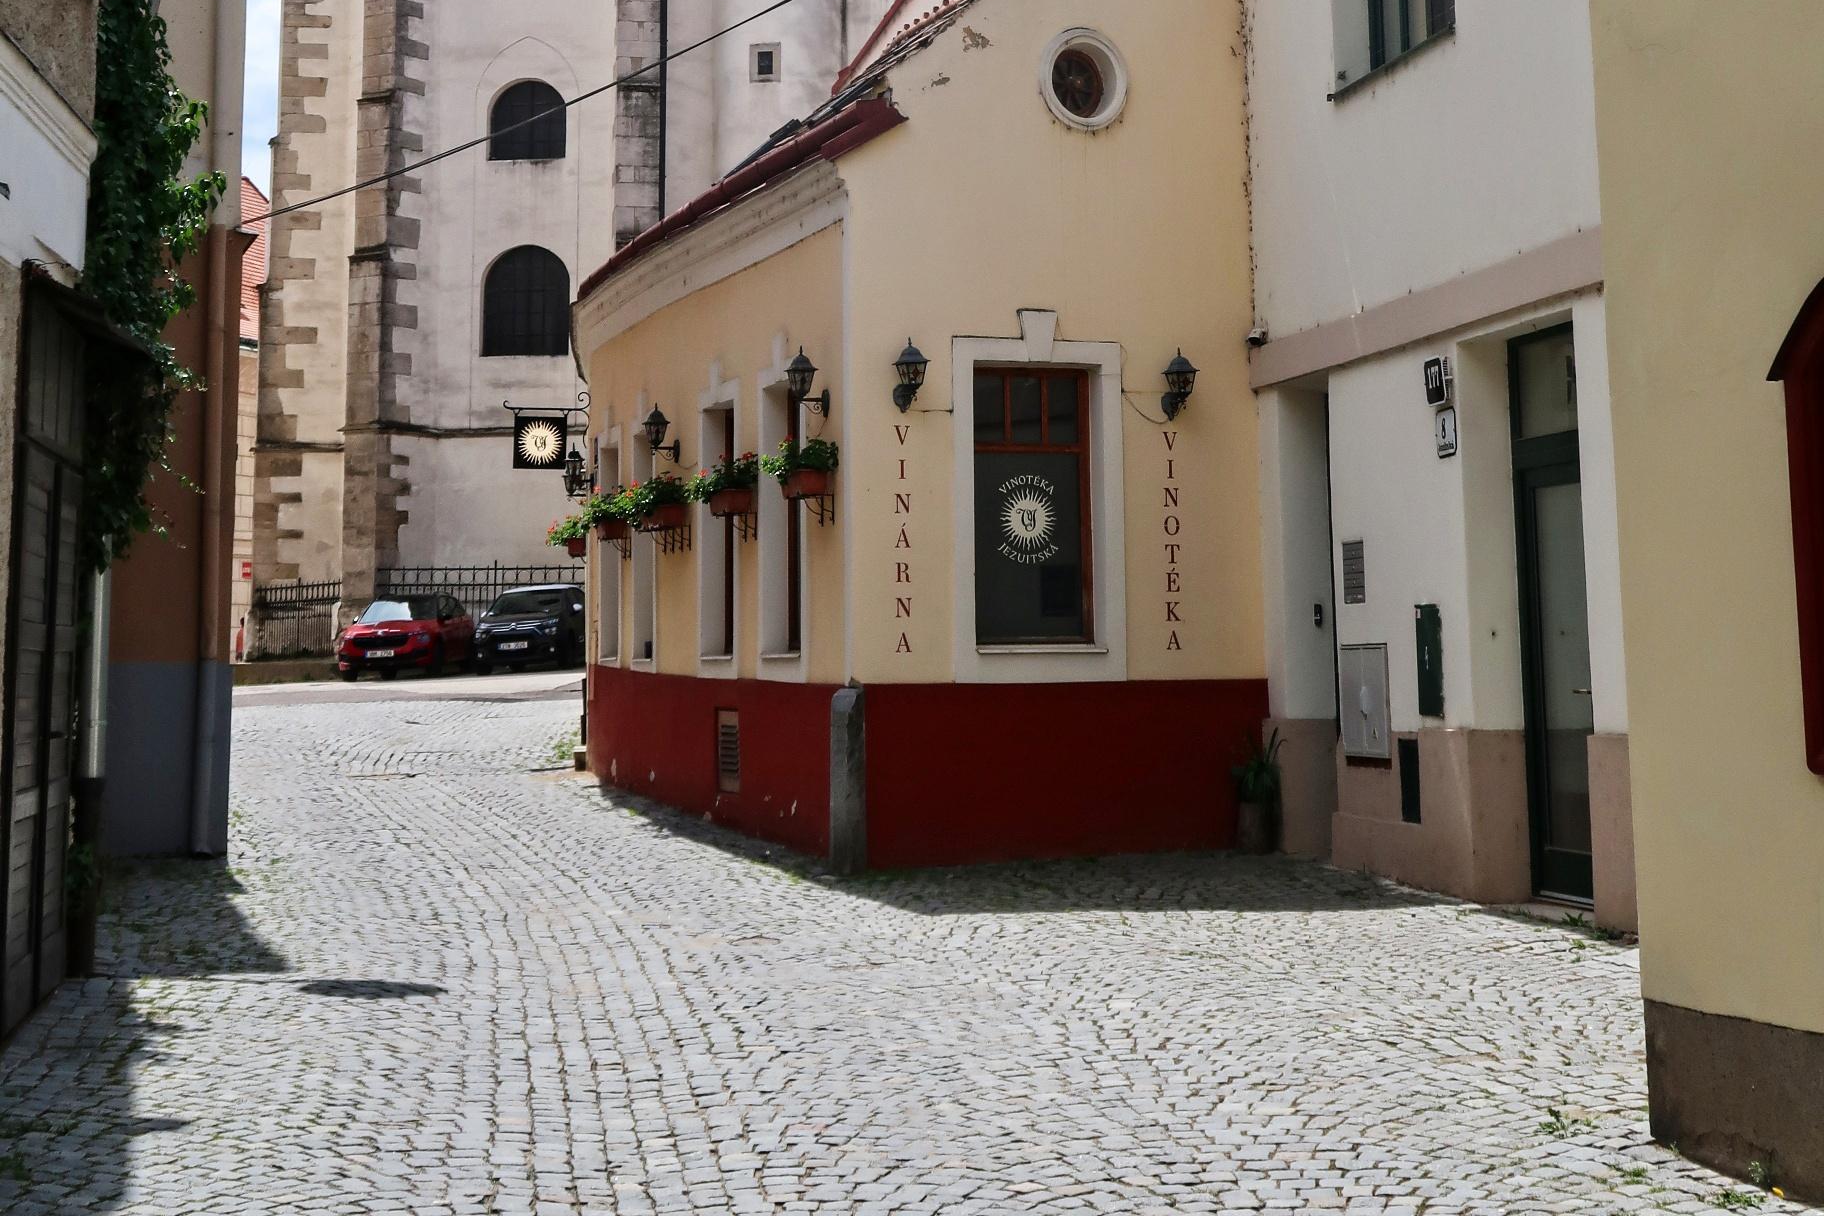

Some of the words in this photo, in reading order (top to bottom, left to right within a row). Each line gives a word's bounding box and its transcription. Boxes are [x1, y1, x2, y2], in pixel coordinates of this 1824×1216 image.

[1427, 365, 1440, 389] 177
[1441, 417, 1447, 440] 8
[998, 474, 1055, 496] VINOTÉKA
[894, 424, 912, 654] VINÁRNA
[1162, 431, 1182, 651] VINOTÉKA
